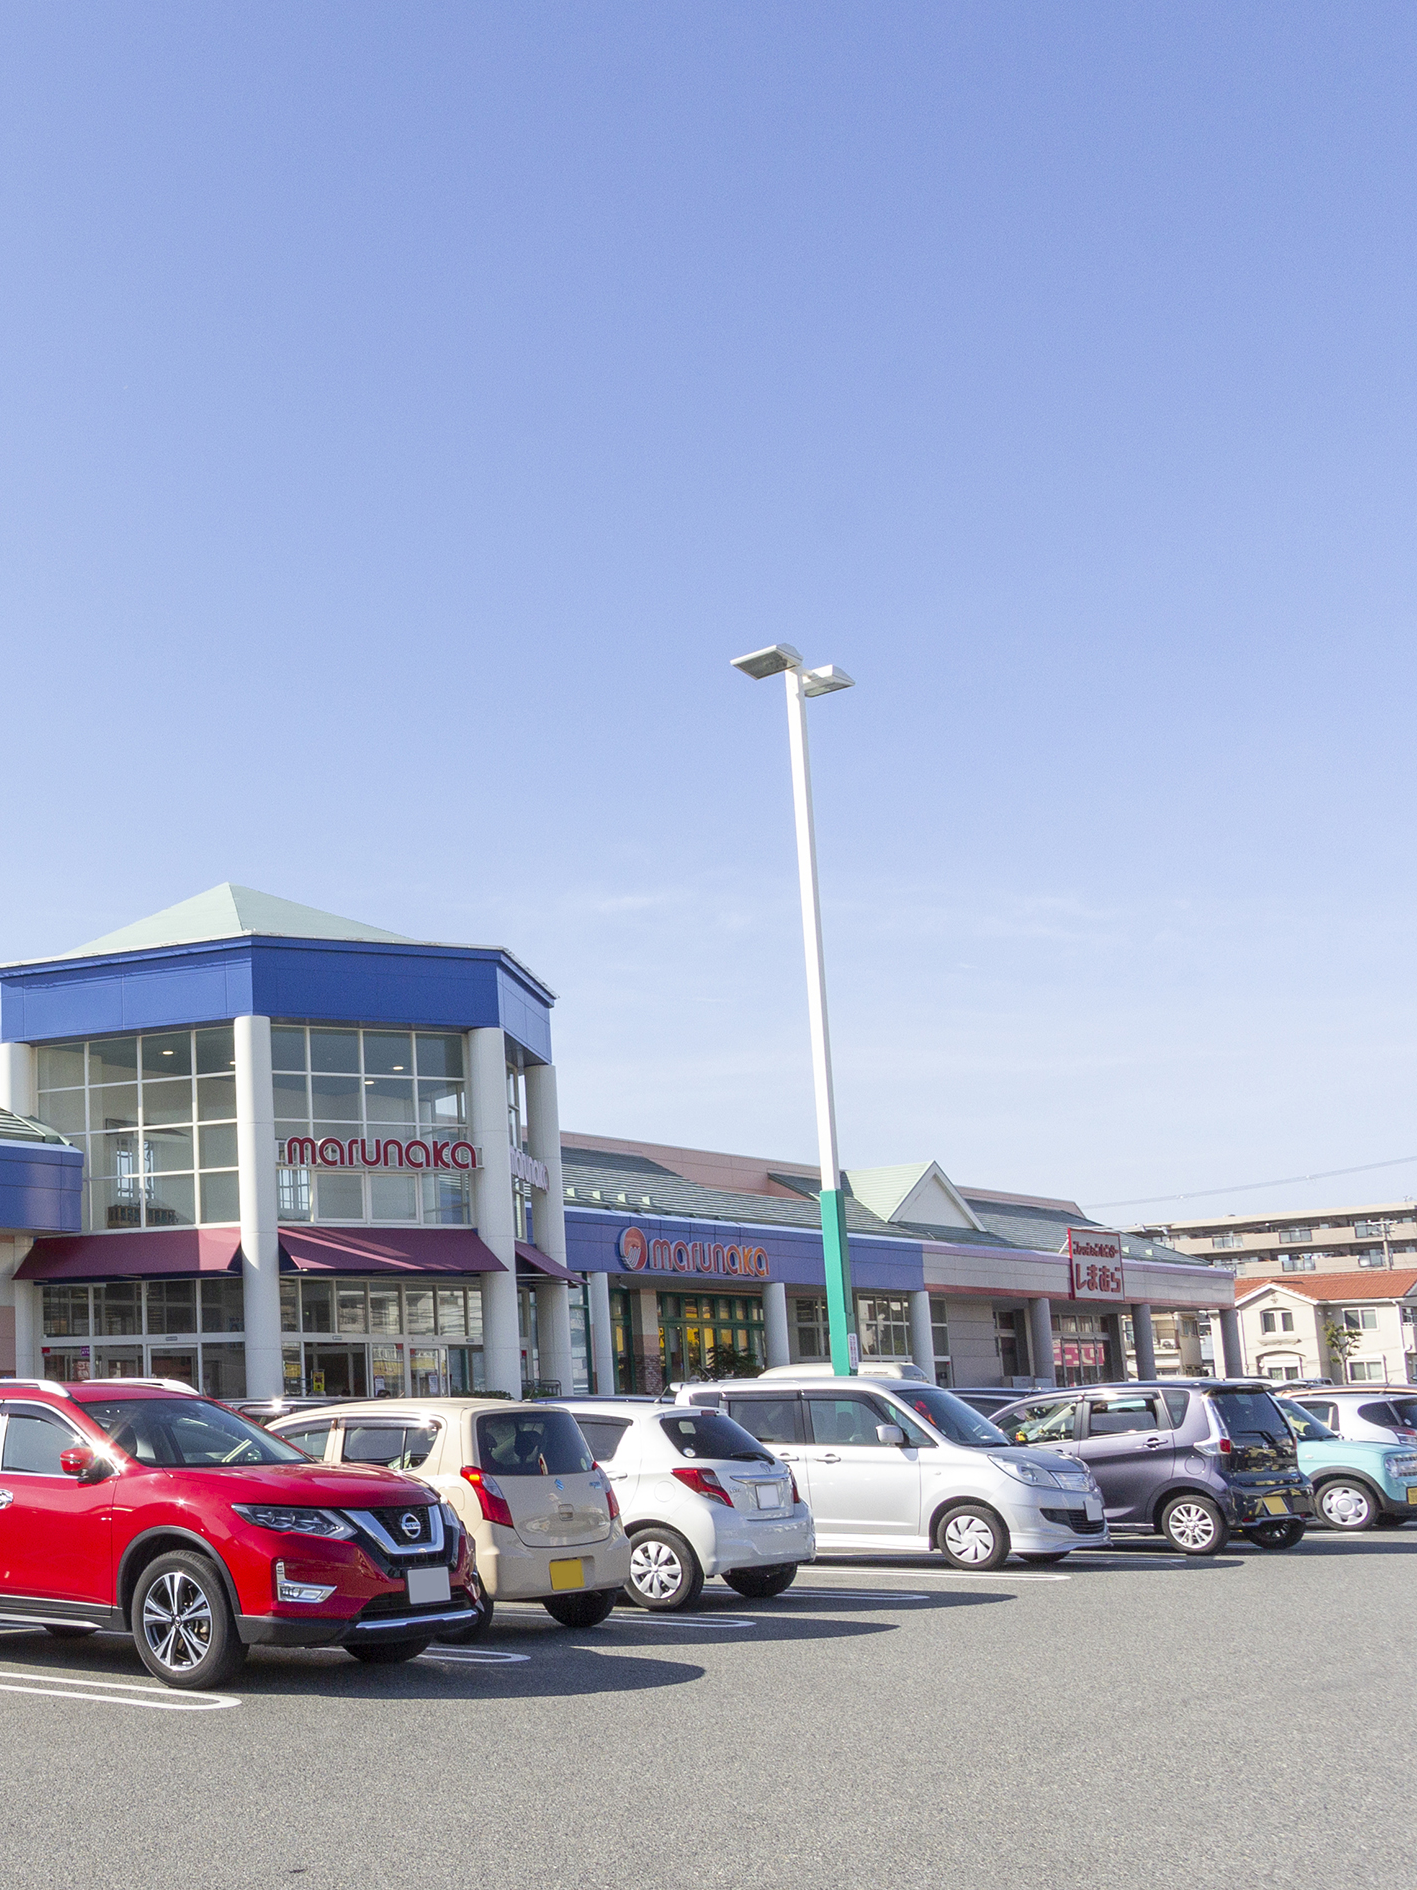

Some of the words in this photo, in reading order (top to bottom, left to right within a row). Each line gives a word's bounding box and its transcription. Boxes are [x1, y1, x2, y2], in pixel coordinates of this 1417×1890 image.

[285, 1136, 478, 1171] marunaka
[649, 1237, 770, 1277] marunaka
[1075, 1263, 1121, 1293] しまむら
